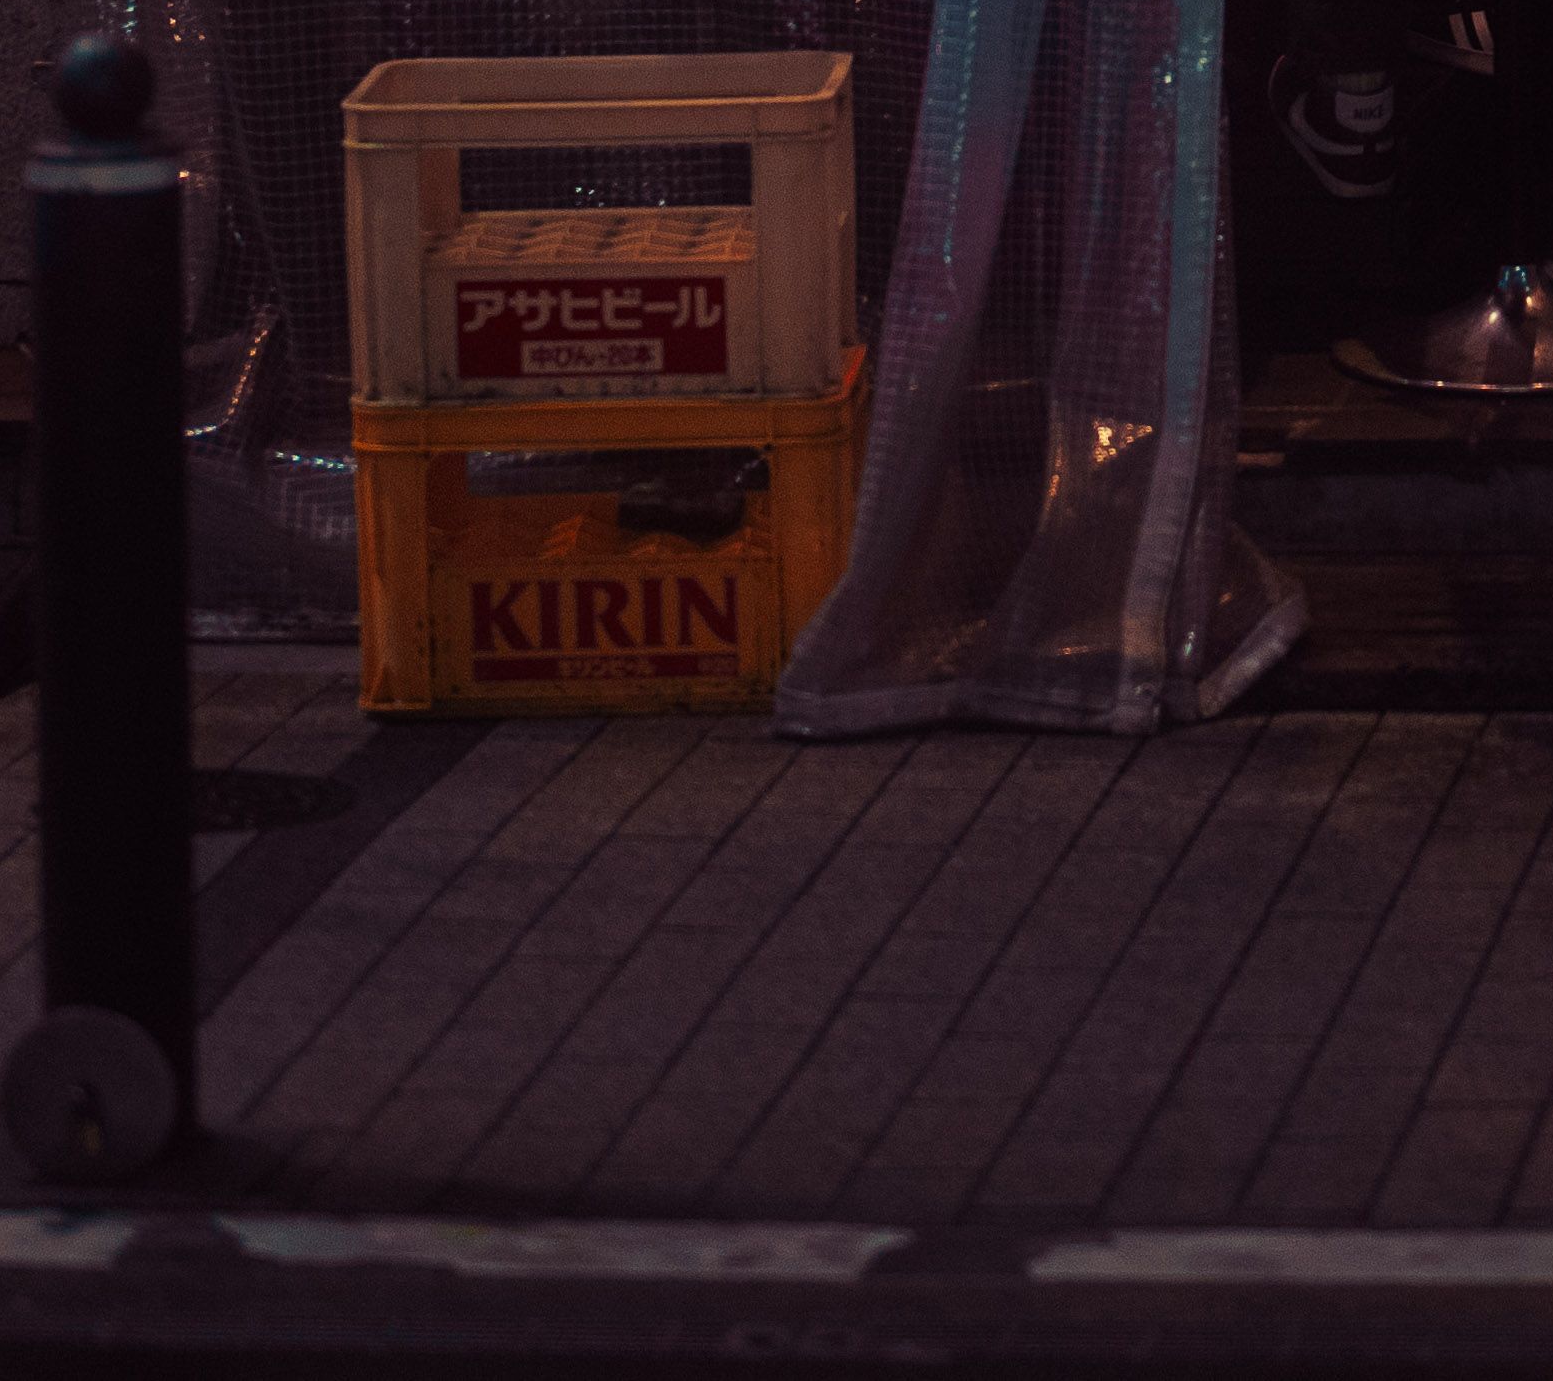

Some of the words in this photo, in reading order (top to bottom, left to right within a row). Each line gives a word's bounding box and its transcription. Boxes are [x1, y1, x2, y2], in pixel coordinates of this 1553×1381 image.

[459, 284, 723, 333] アサヒビール
[471, 575, 739, 652] KIRIN
